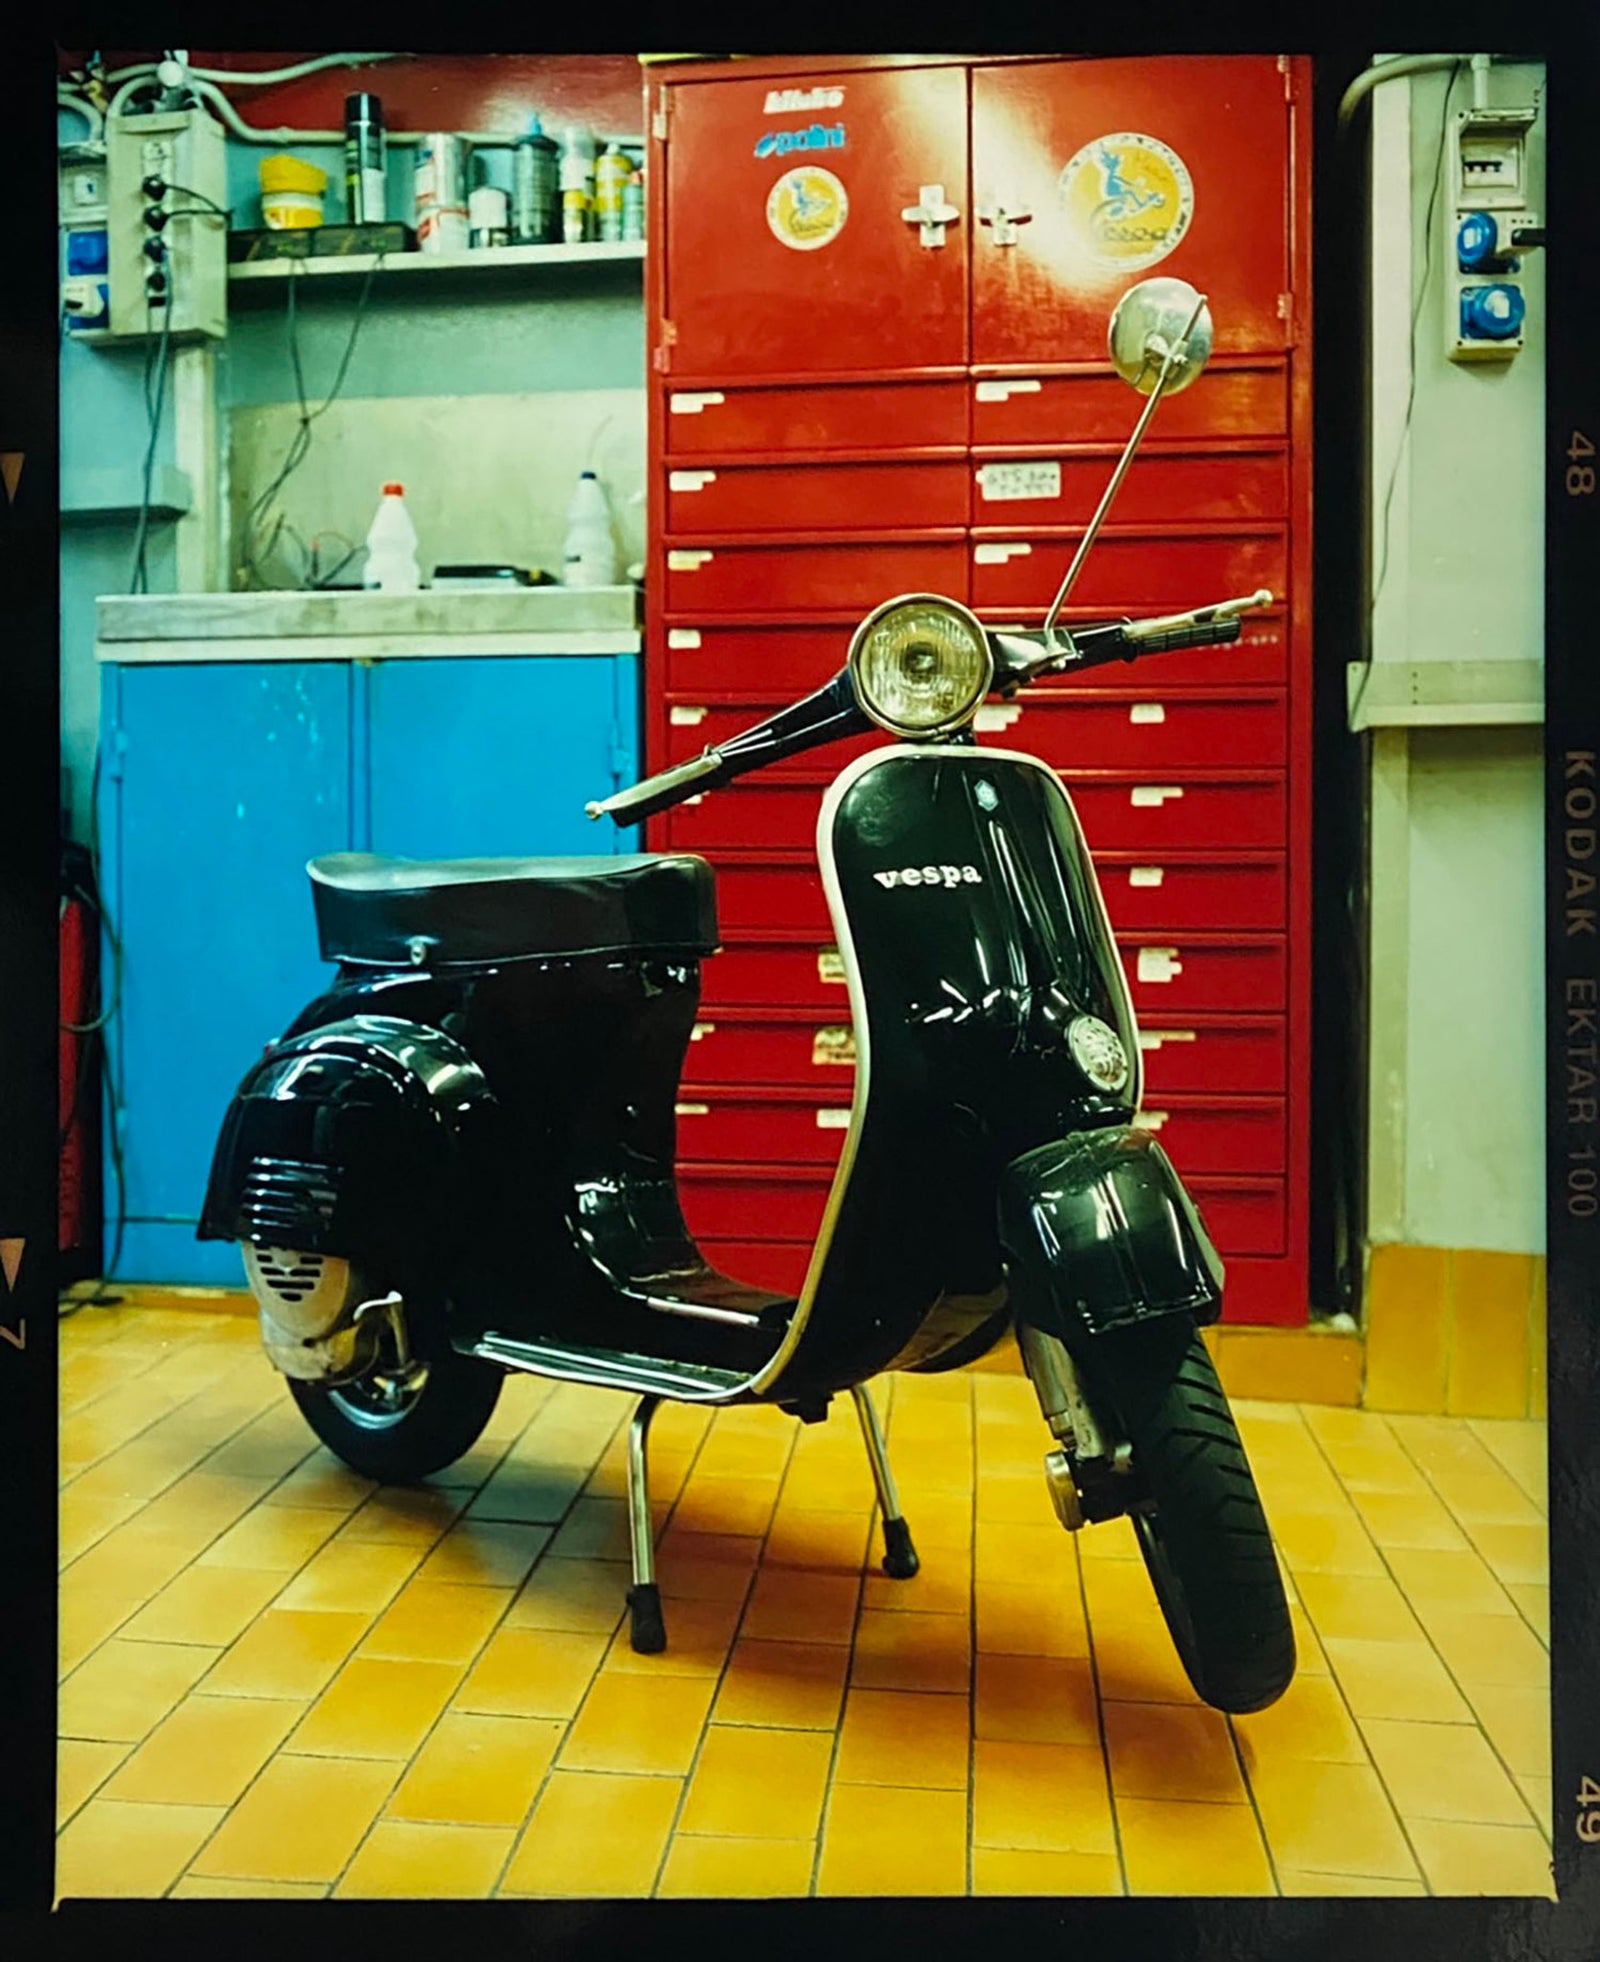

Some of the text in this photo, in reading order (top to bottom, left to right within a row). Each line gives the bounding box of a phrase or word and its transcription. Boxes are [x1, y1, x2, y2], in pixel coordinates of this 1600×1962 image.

[1565, 430, 1597, 497] 48
[872, 865, 983, 889] vespa
[1565, 751, 1598, 1217] KODAK EKTAR 100
[1576, 1775, 1600, 1843] 49
